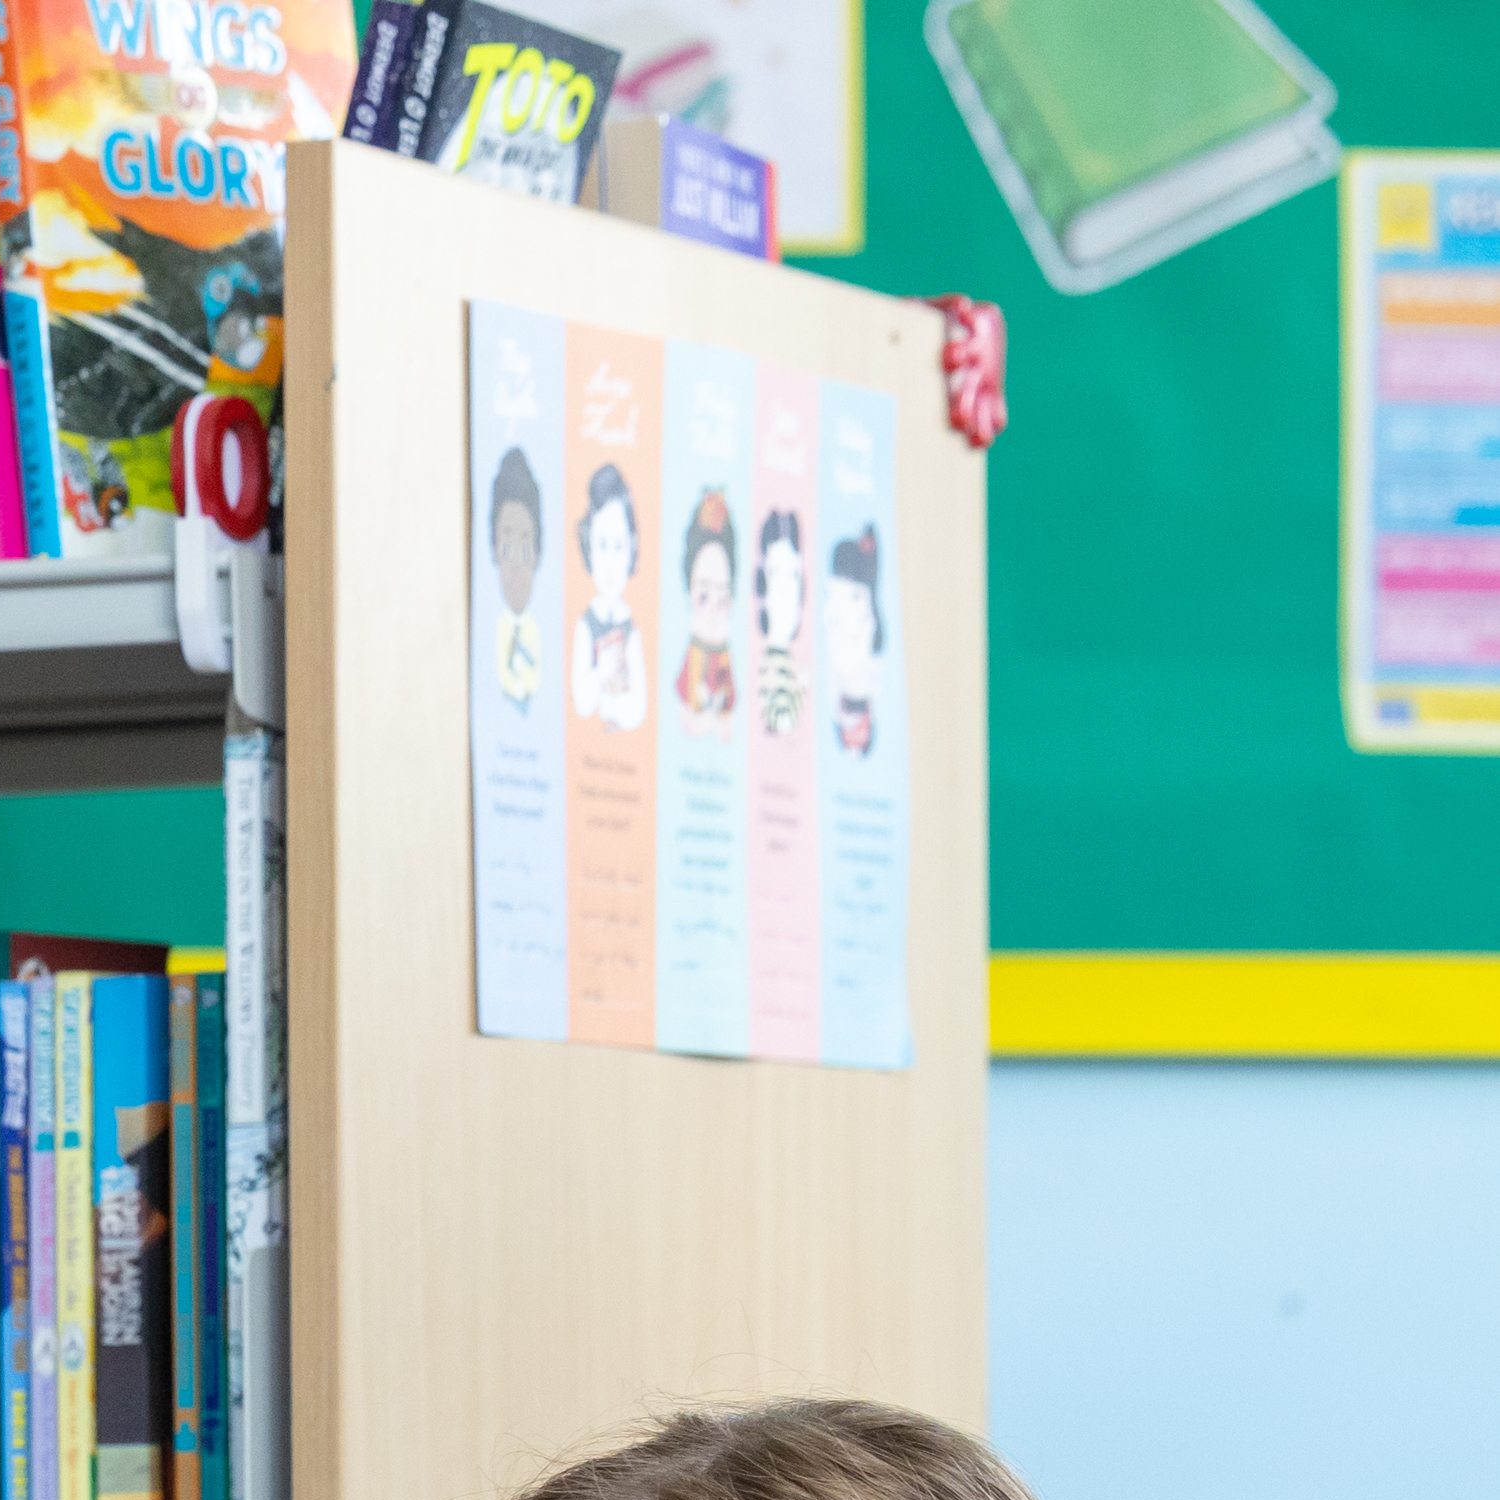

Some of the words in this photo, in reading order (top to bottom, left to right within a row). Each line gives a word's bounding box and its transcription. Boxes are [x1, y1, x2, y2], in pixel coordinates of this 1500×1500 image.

[87, 0, 287, 76] WINGS
[455, 41, 597, 174] TOTO
[103, 127, 287, 214] GLORY
